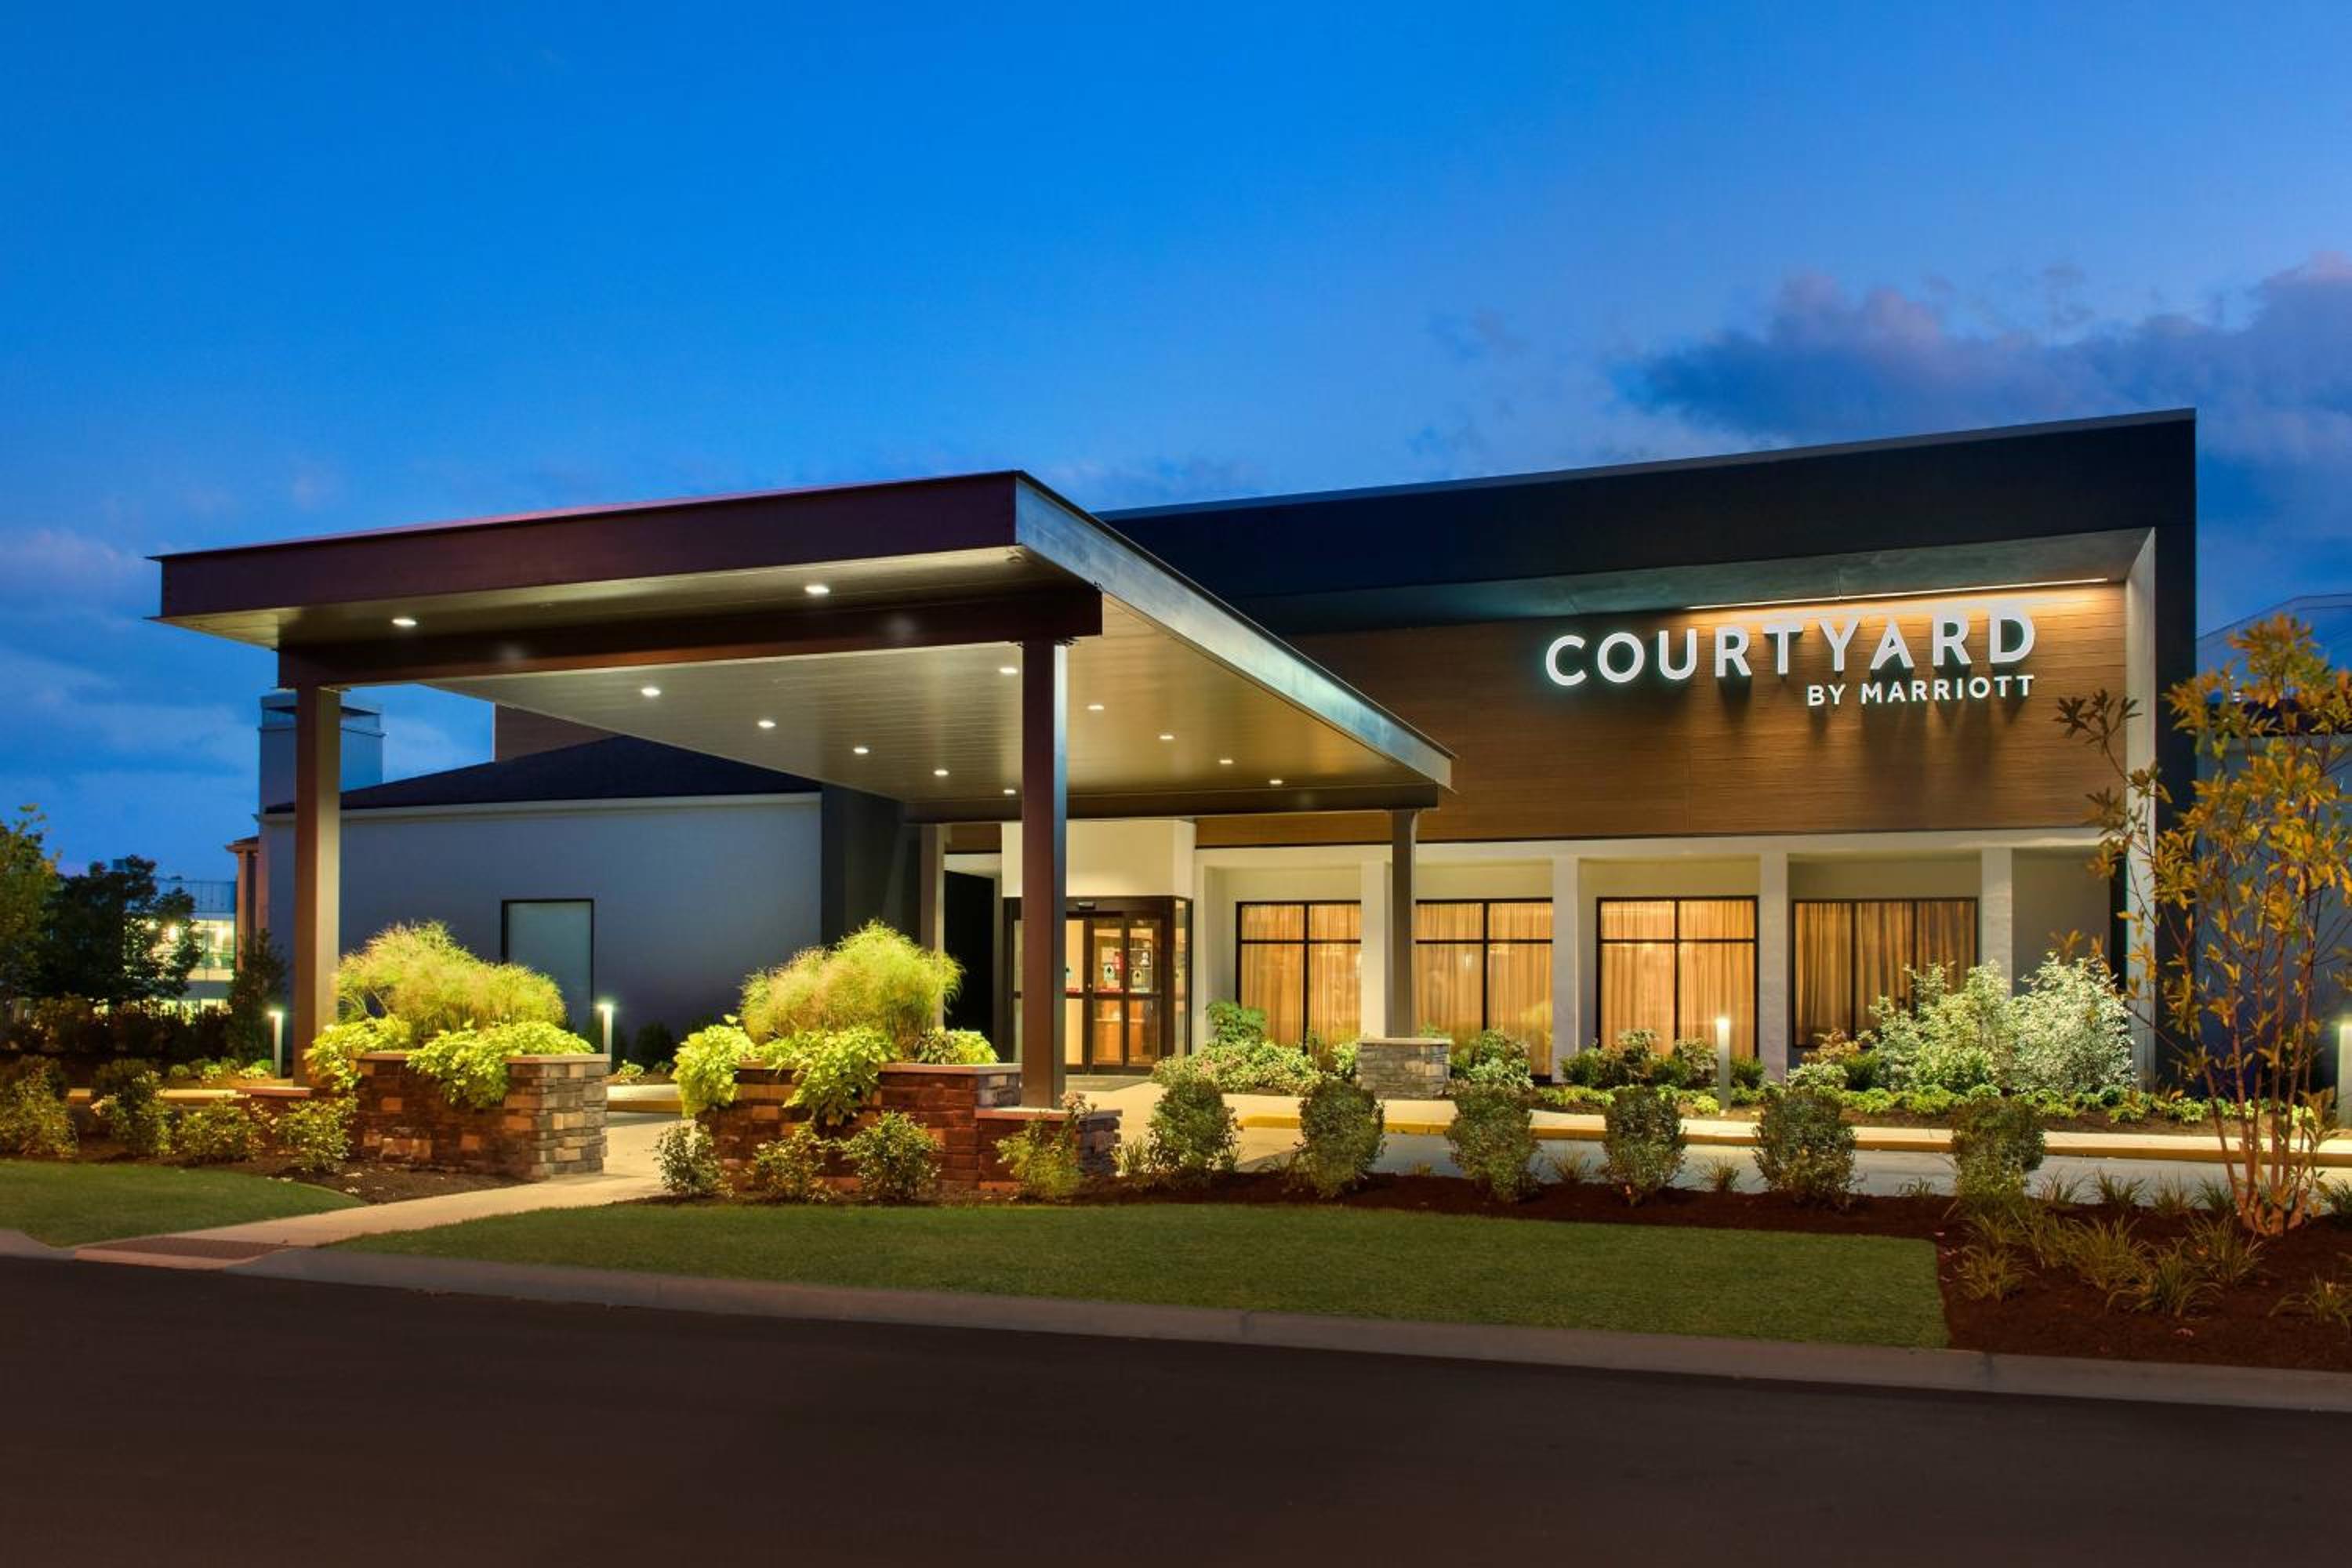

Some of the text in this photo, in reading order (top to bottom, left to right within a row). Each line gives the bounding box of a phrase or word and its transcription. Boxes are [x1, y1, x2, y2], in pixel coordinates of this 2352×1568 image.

[1545, 608, 2035, 686] COURTYARD
[1807, 675, 2034, 706] BY MARRIOTT
